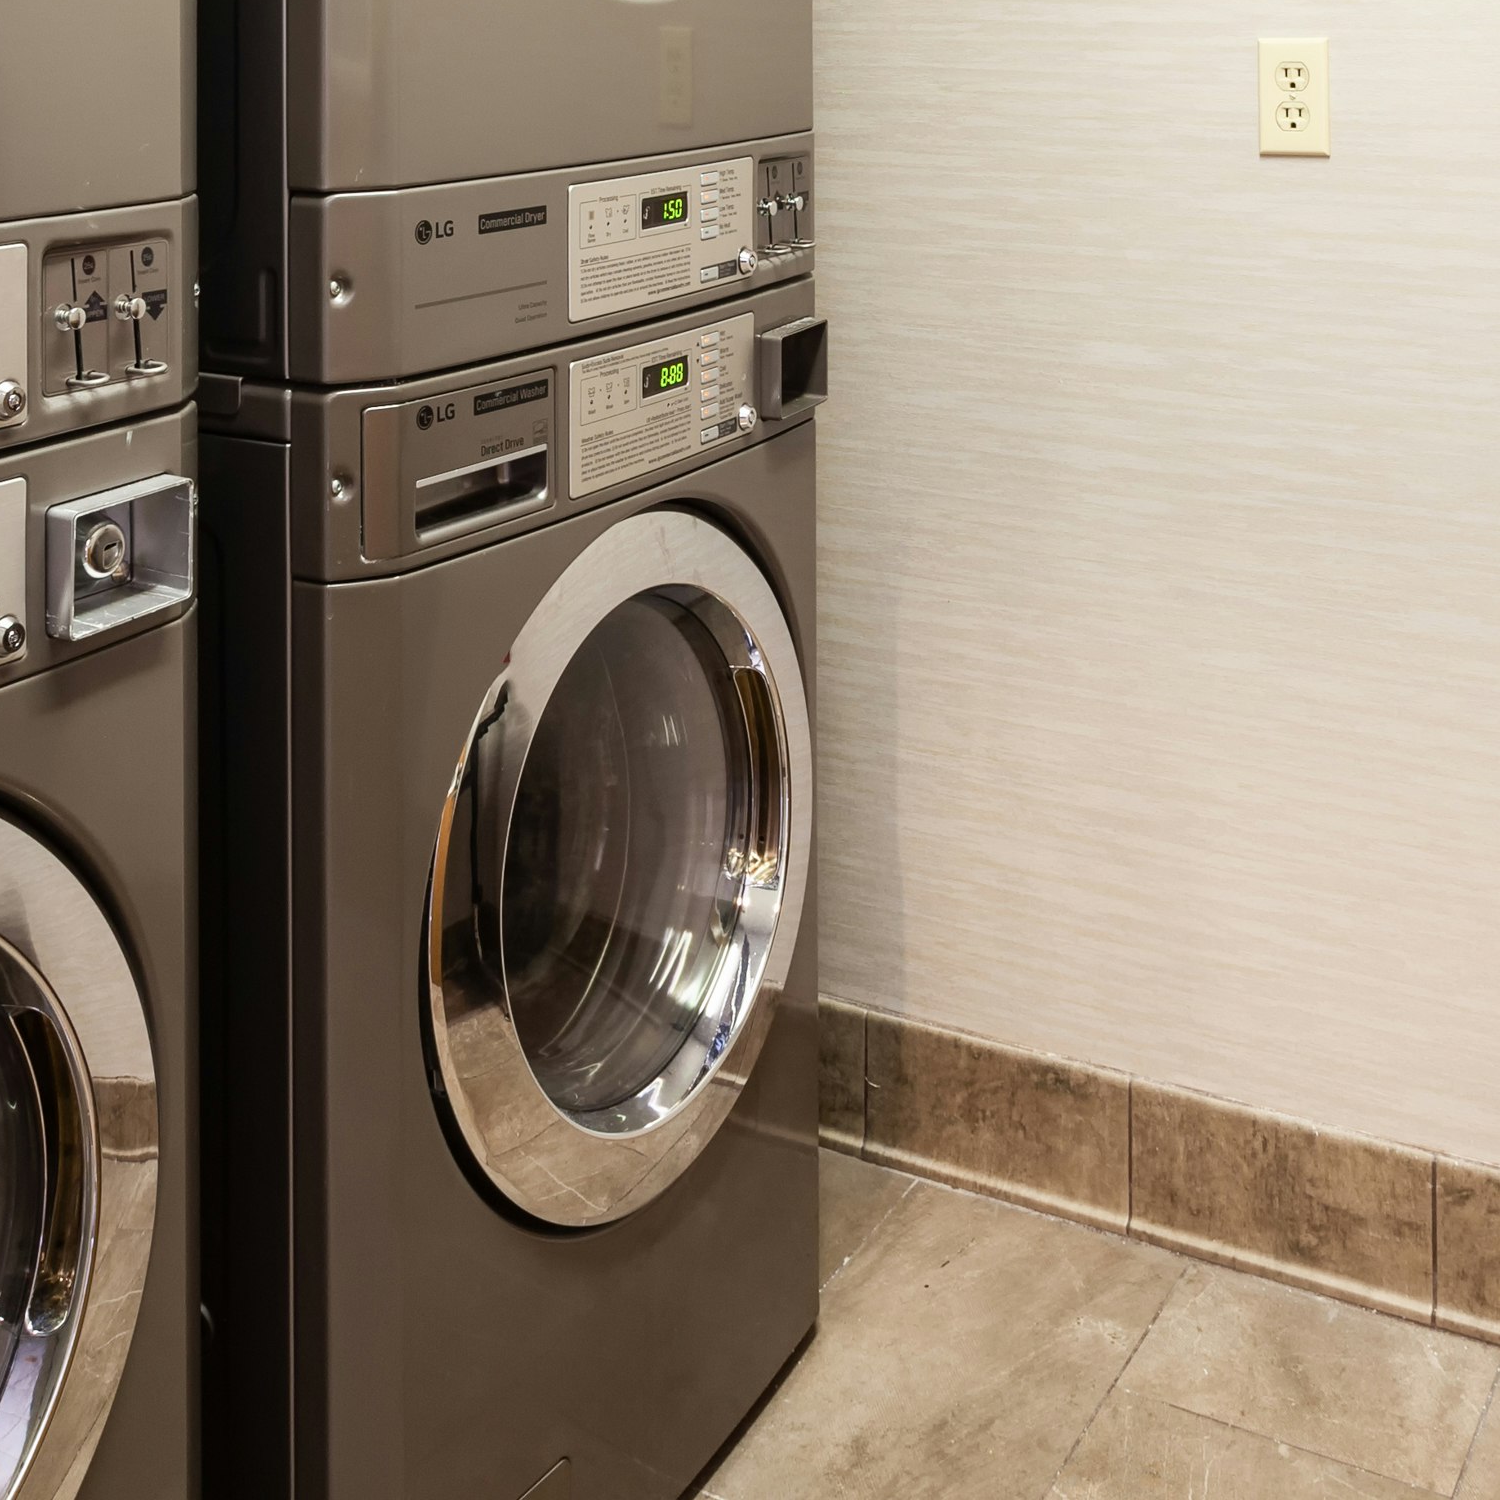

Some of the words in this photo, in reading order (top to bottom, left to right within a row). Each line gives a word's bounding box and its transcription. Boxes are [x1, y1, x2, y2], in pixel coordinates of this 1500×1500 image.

[435, 220, 454, 238] LG
[480, 214, 524, 229] Commercial
[525, 211, 545, 223] Dryer
[476, 391, 518, 411] Commercial
[520, 384, 547, 400] Washer
[437, 403, 455, 423] LG
[481, 443, 504, 457] Direct
[505, 437, 524, 450] Drive
